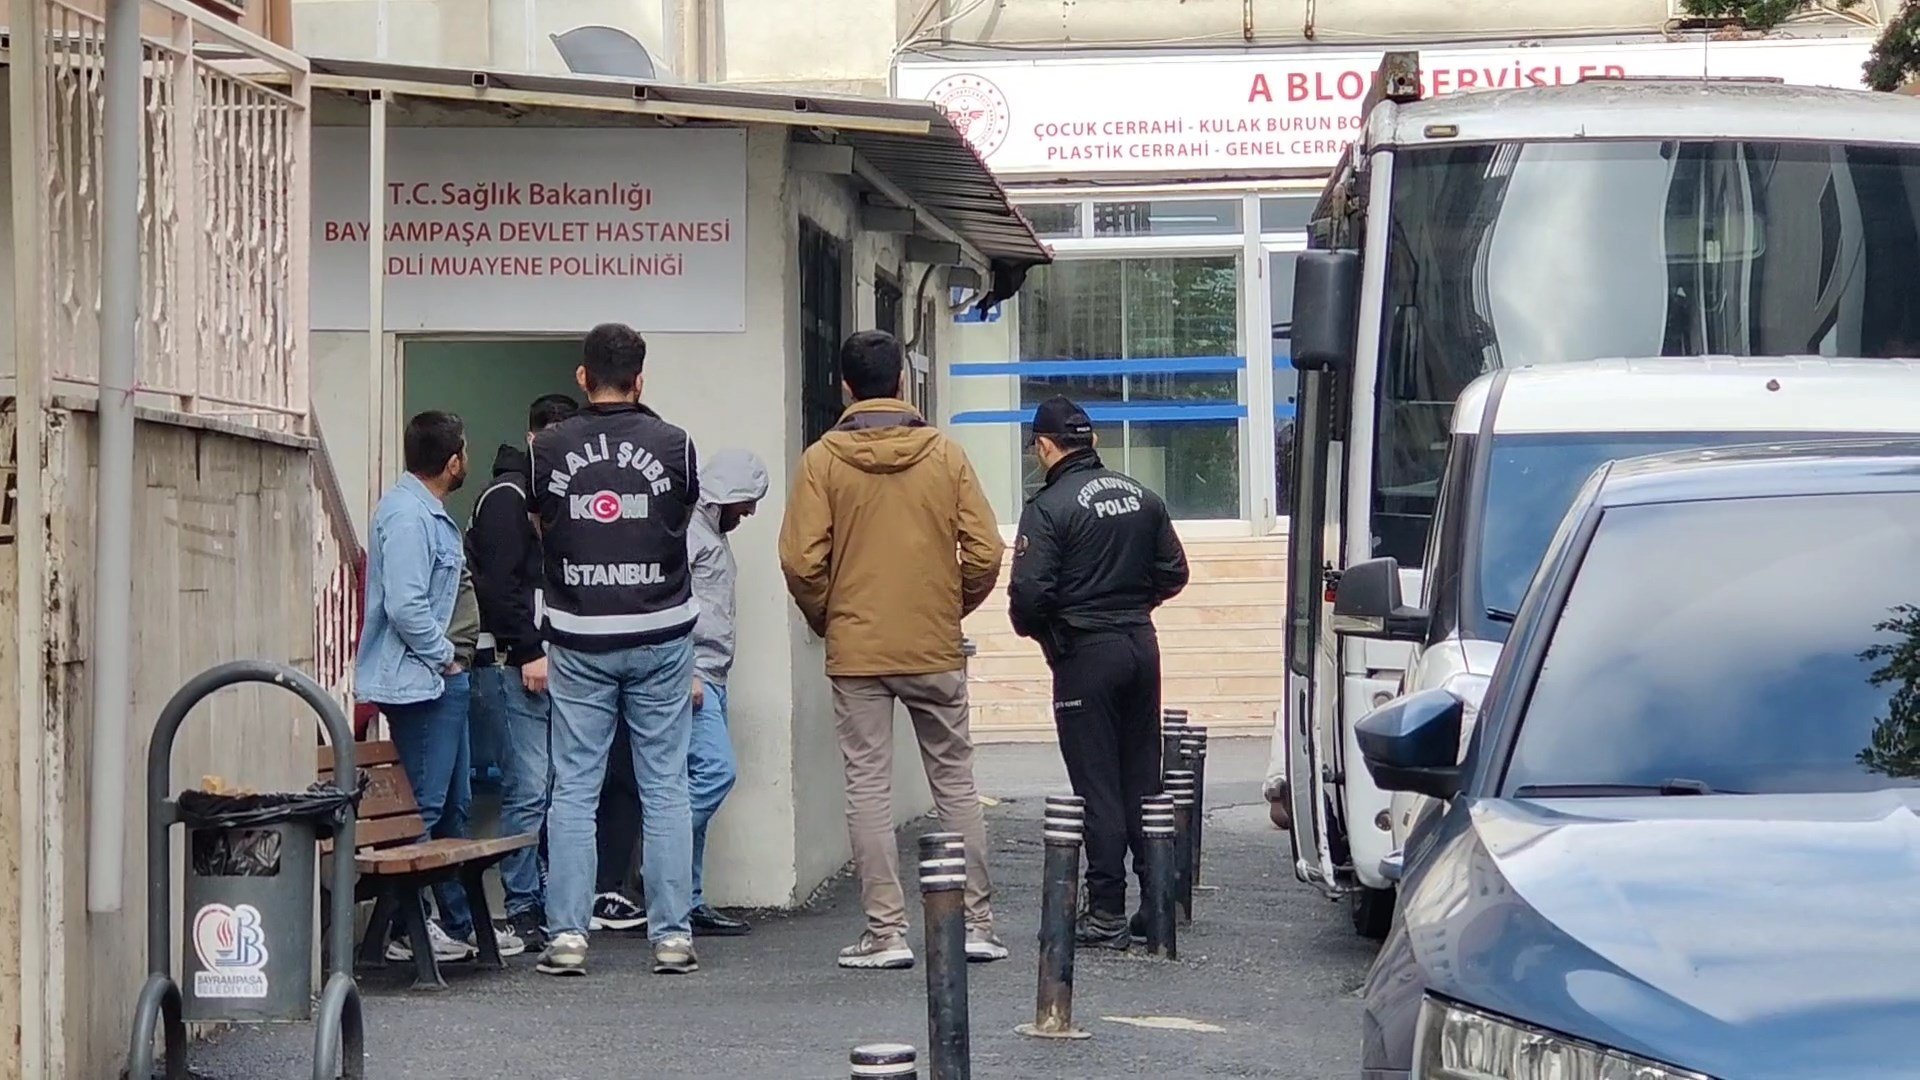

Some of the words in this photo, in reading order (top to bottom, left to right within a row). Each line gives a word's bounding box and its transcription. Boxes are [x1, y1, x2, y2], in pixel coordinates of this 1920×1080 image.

[1248, 73, 1273, 102] A
[1034, 122, 1097, 141] ÇOCUK
[1103, 117, 1182, 135] CERRAHİ
[1200, 119, 1261, 133] KULAK
[1267, 116, 1331, 131] BURUN
[1048, 142, 1123, 159] PLASTİK
[1129, 140, 1209, 157] CERRAHİ
[1226, 141, 1285, 156] GENEL
[530, 182, 652, 211] Bakanlığı
[325, 222, 492, 246] BAYAMPAŞA
[500, 222, 589, 241] DEVLET
[597, 218, 730, 242] HASTANESİ
[383, 253, 424, 275] DLİ
[431, 257, 543, 275] MUAYENE
[551, 253, 683, 276] POLİKLİNİĞİ
[548, 433, 609, 497] MALİ
[617, 441, 672, 496] ŞUBE
[562, 557, 666, 586] İSTANBUL
[604, 903, 620, 915] N
